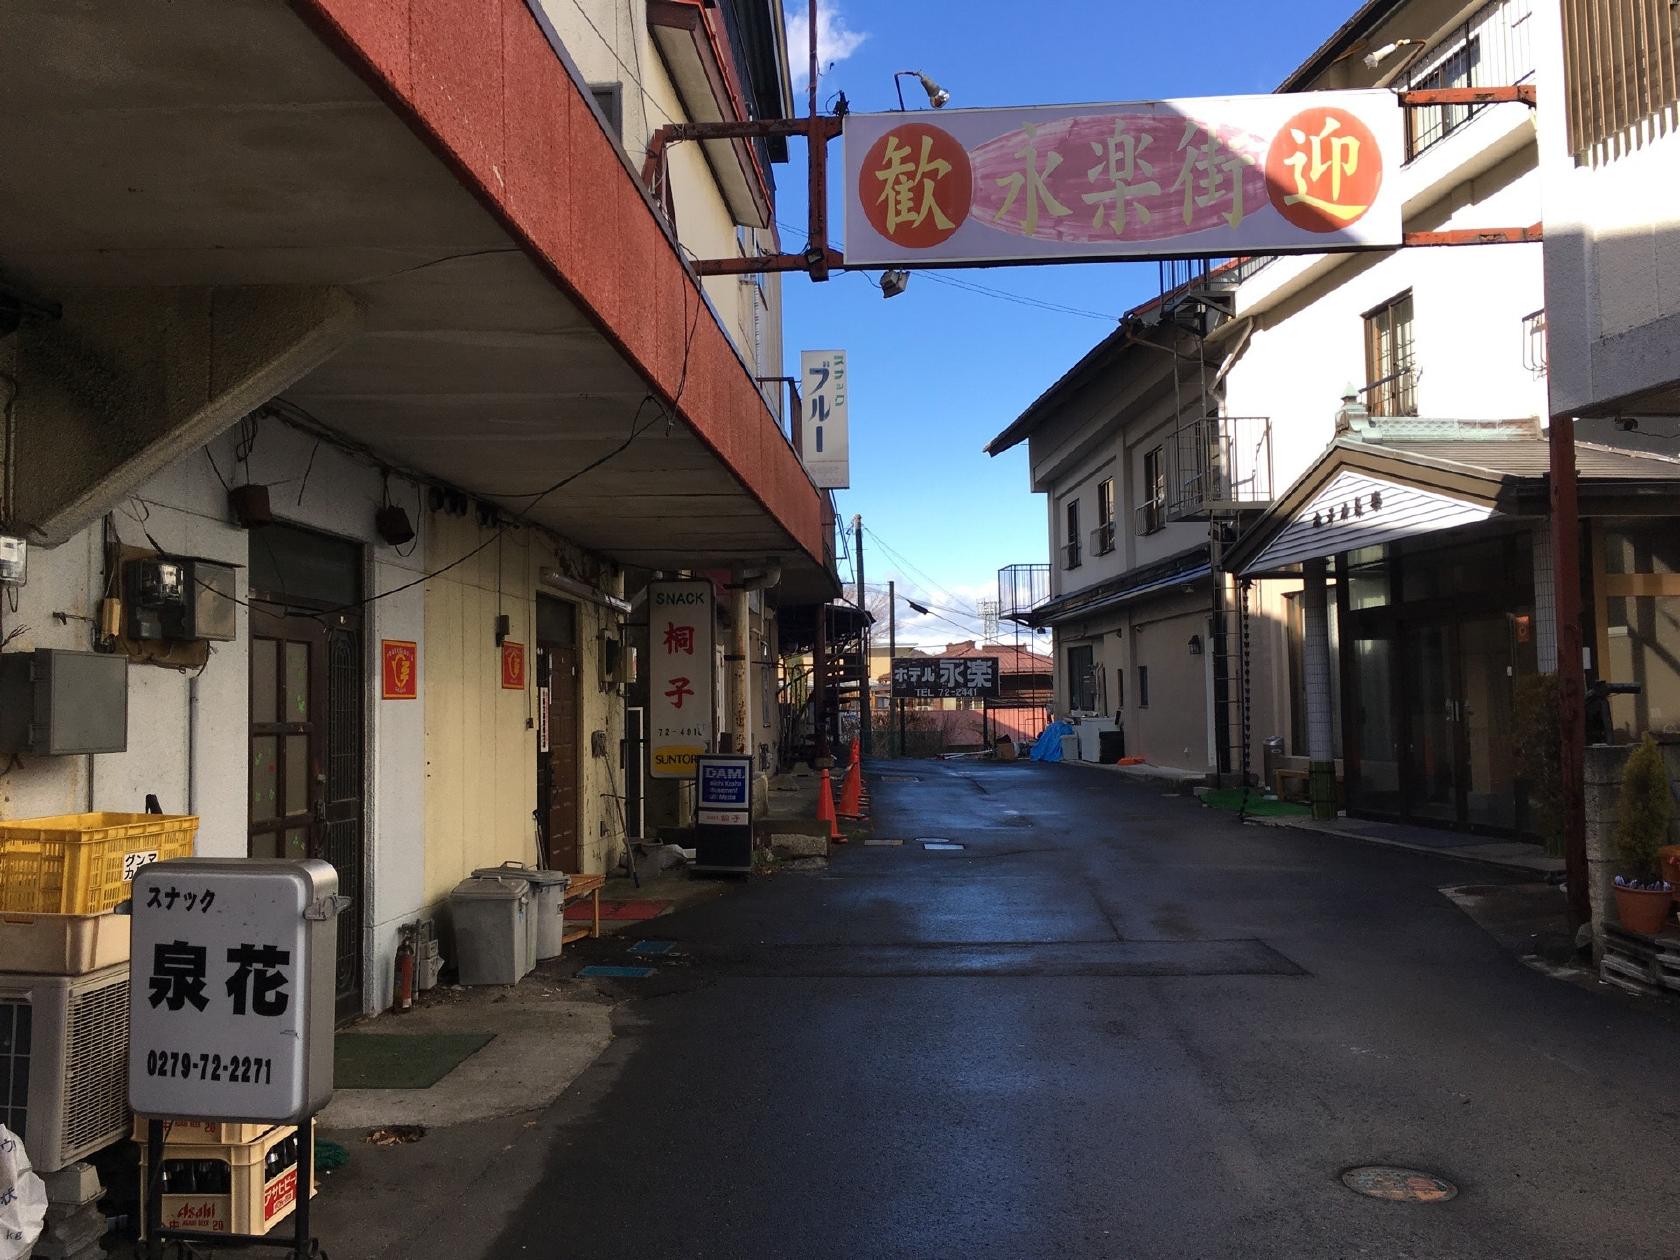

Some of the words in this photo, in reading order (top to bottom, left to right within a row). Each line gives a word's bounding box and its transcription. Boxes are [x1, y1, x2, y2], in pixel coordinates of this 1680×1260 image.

[875, 134, 956, 235] 歓
[992, 118, 1254, 236] 永楽街
[1282, 116, 1370, 221] 迎
[808, 361, 831, 452] ブルー
[655, 592, 704, 605] SNACK
[663, 621, 695, 709] 桐子
[894, 659, 993, 688] ホテル永楽
[914, 688, 934, 697] TEL
[938, 688, 978, 697] 72-2441
[125, 853, 157, 868] グンマ
[146, 886, 217, 914] スナック
[148, 939, 292, 1017] 泉花
[147, 1050, 272, 1085] 0279-72-2271
[264, 1172, 298, 1207] アサヒビー
[177, 1202, 216, 1219] Asahi
[212, 1220, 224, 1231] 20
